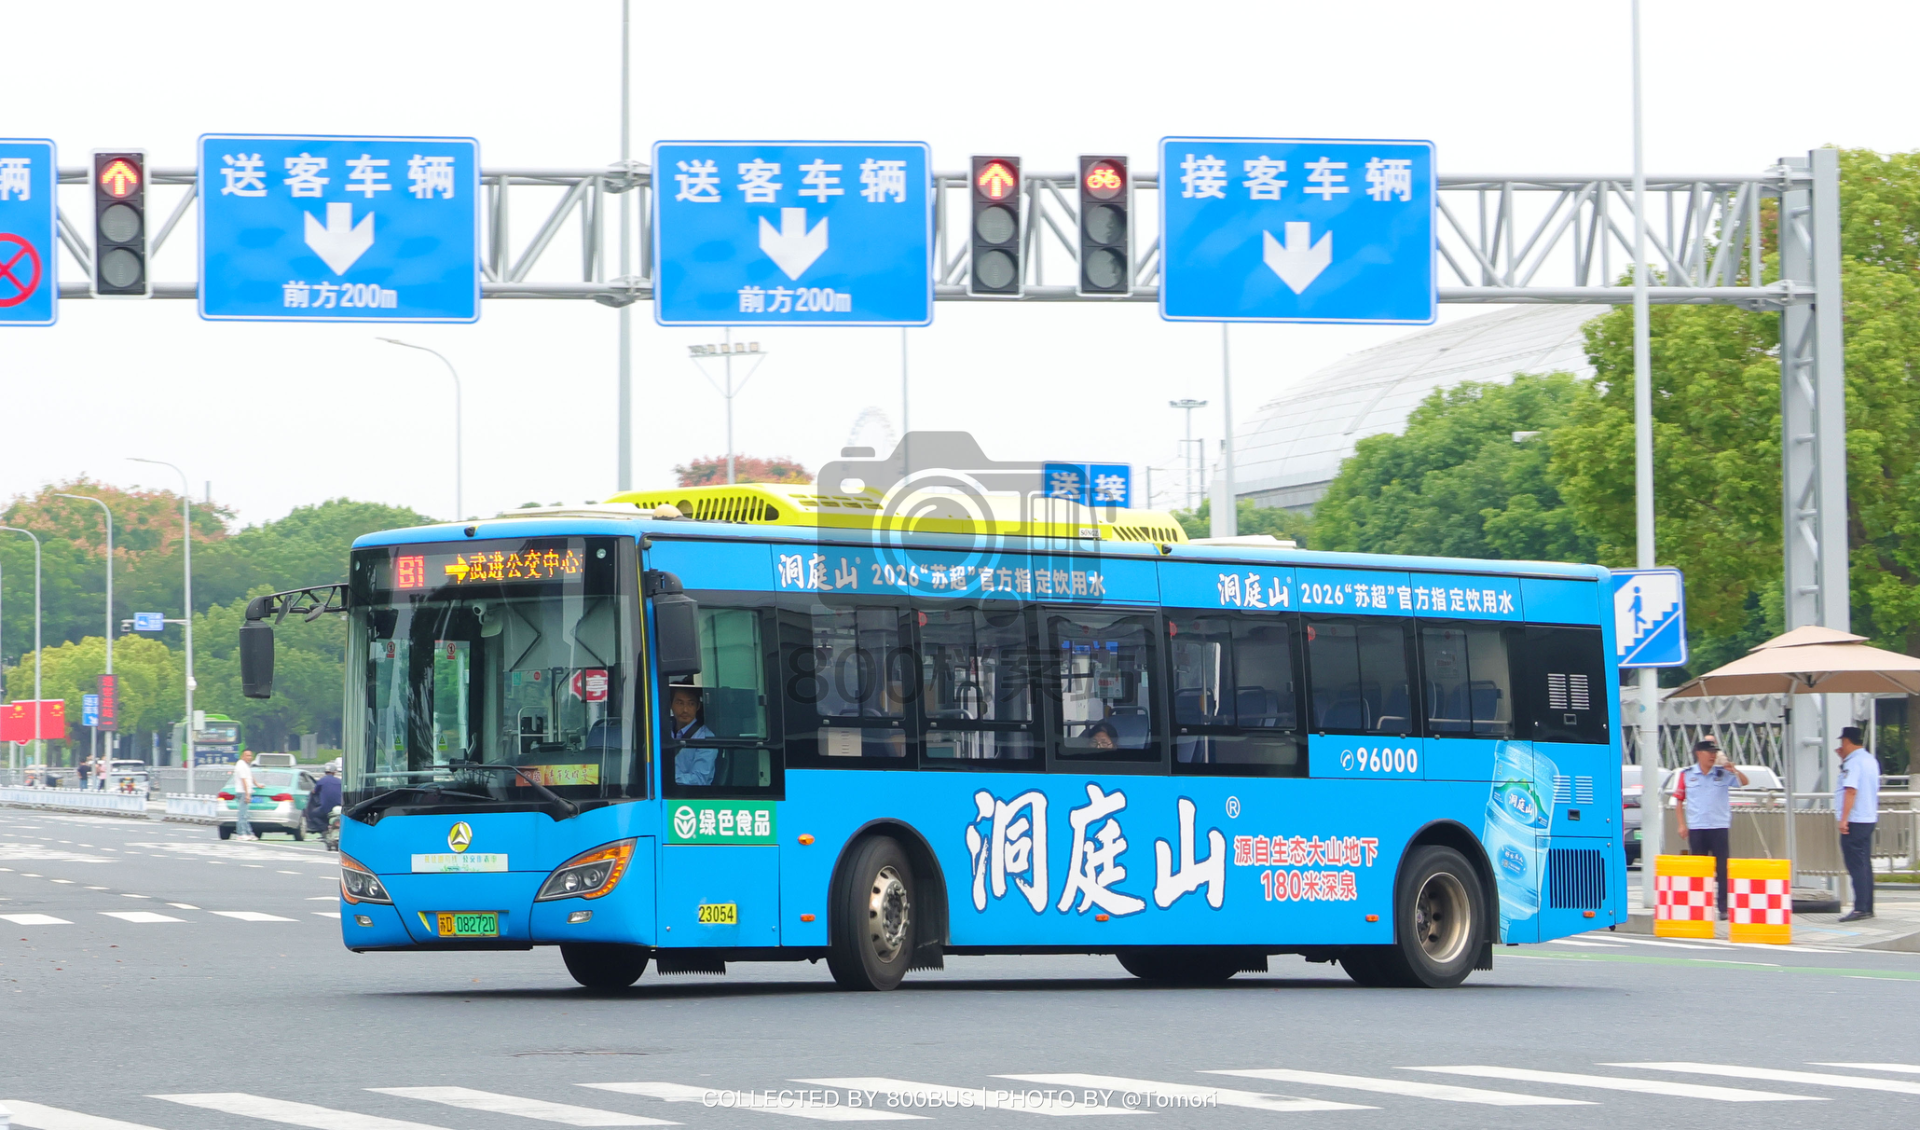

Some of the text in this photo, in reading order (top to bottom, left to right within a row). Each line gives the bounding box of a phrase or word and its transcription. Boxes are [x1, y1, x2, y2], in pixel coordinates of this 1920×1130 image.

[220, 152, 456, 200] 送客车辆
[674, 158, 907, 203] 送客车辆
[1180, 154, 1413, 202] 接客车辆
[282, 279, 398, 310] 前方200m
[738, 286, 852, 314] 前方200m
[1050, 472, 1126, 502] 送 接
[398, 555, 424, 588] B1
[778, 553, 859, 591] 洞庭山
[1217, 571, 1514, 614] 洞庭山 2026“苏超”官方指定饮用水
[1356, 746, 1418, 773] 96000
[699, 808, 771, 836] 绿色食品
[965, 782, 1226, 916] 洞庭山
[1233, 835, 1379, 868] 源自生态大山地下
[1260, 870, 1358, 901] 180米深泉
[698, 905, 734, 923] 23054
